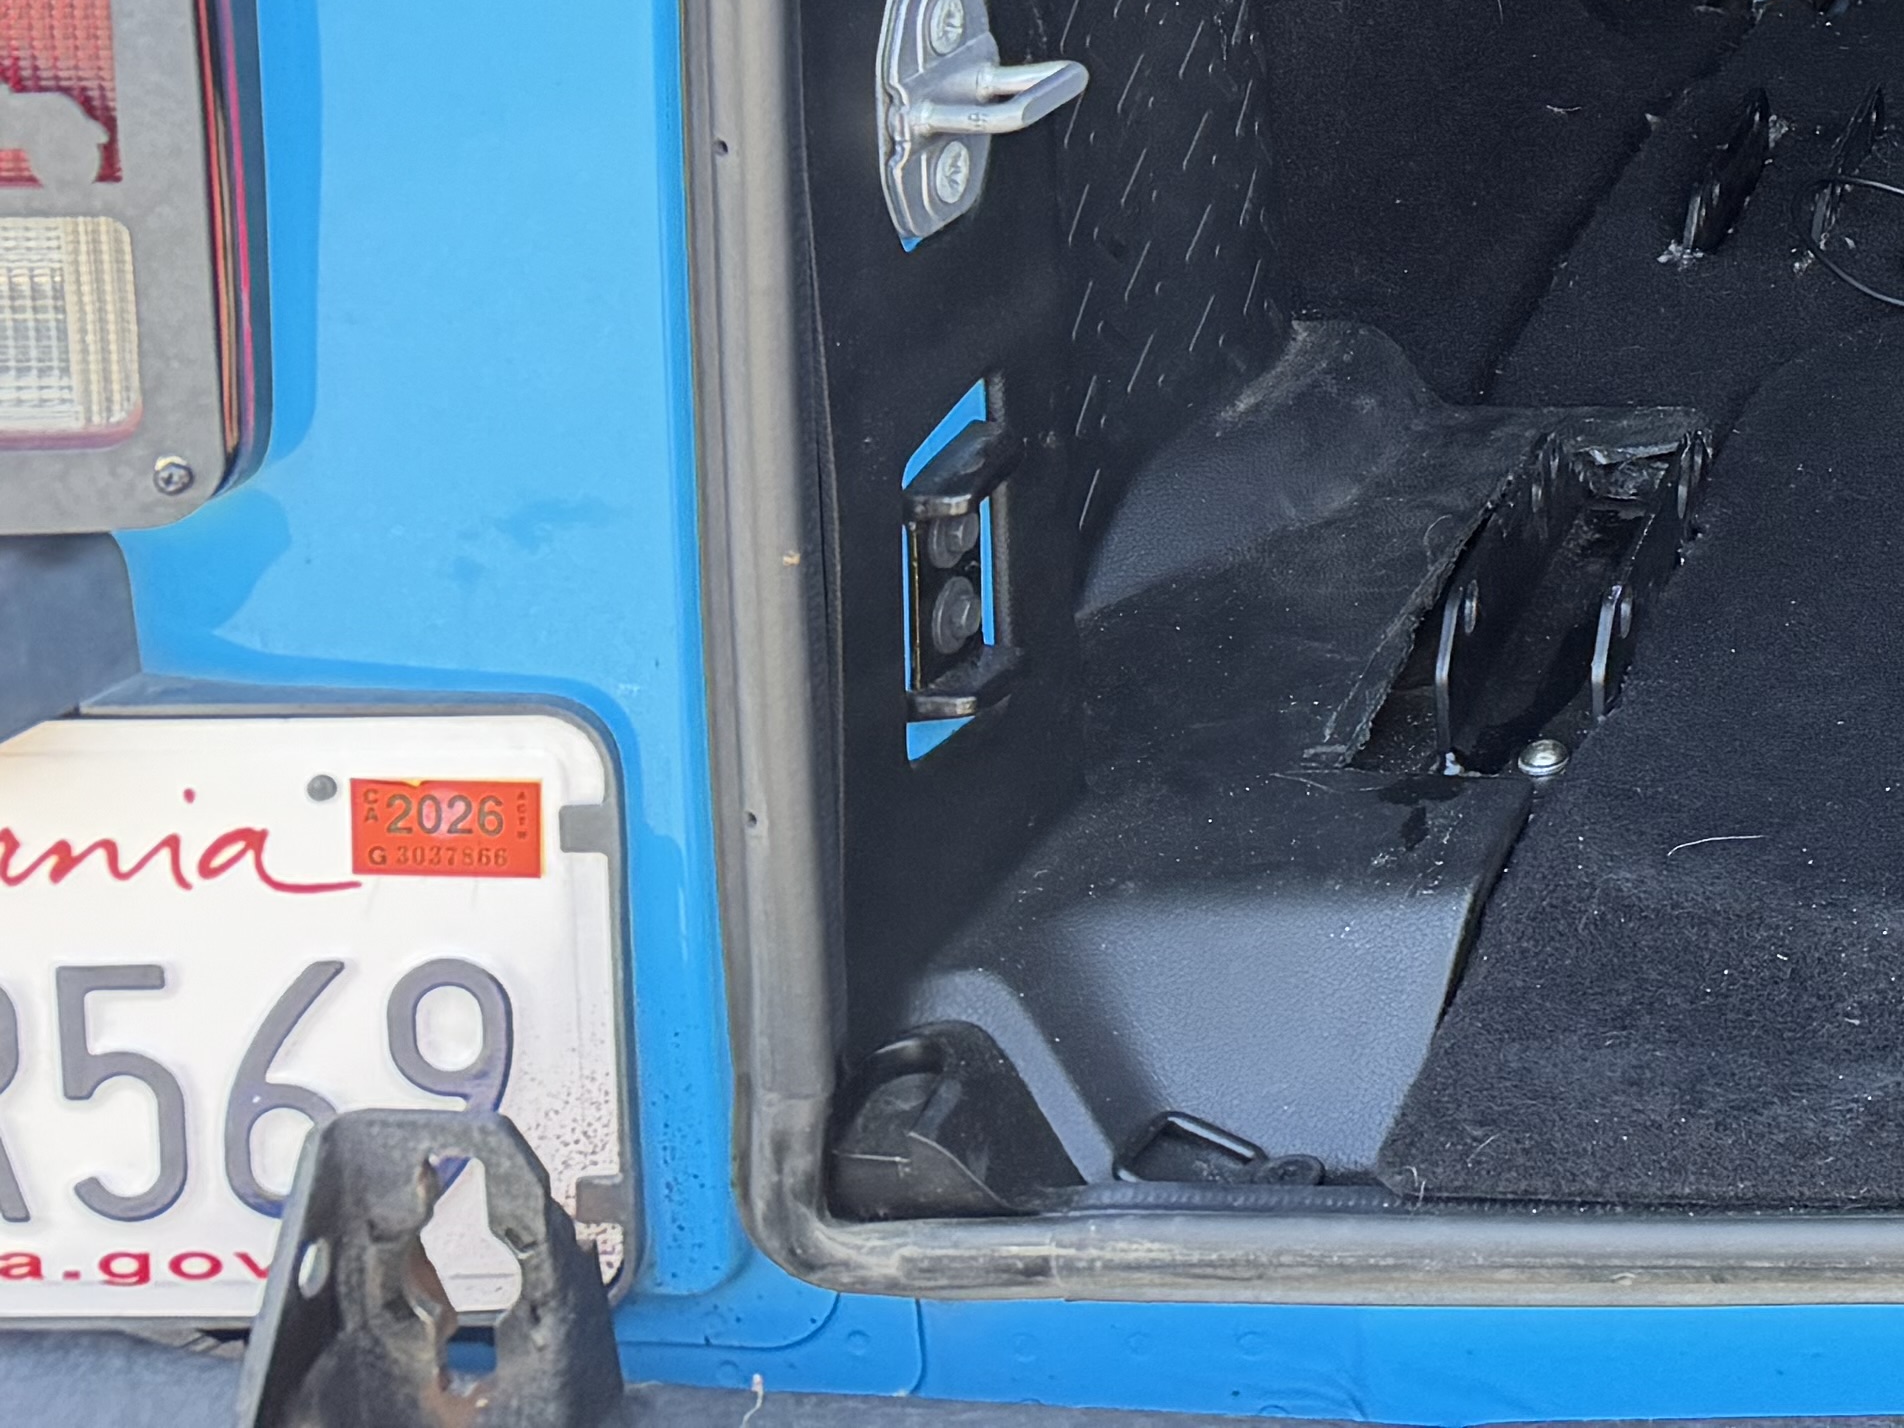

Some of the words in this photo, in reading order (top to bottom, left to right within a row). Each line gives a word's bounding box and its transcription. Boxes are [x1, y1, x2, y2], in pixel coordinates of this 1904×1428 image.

[386, 793, 504, 837] 2026
[368, 846, 387, 866] G
[0, 957, 514, 1223] 569
